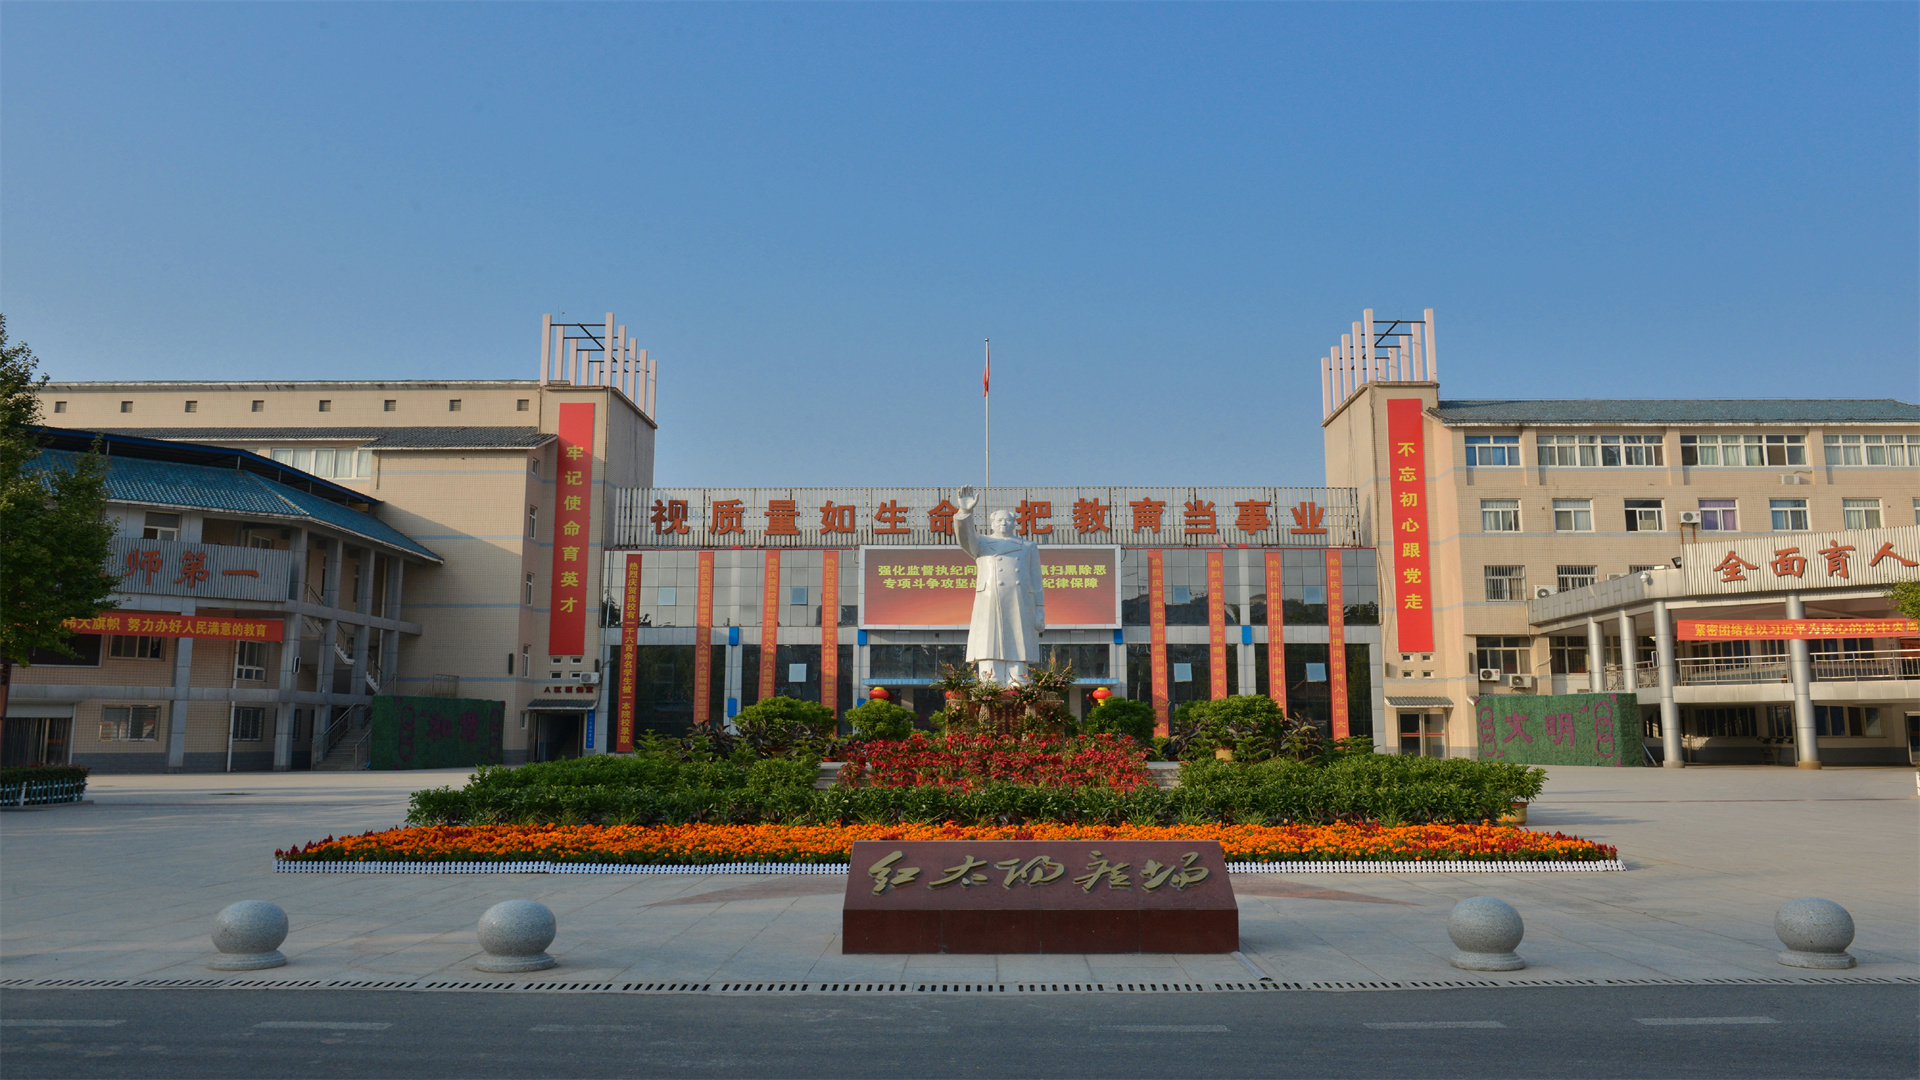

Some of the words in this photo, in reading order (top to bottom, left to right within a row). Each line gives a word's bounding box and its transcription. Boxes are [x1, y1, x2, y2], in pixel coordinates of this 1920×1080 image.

[560, 445, 584, 613] 牢记使命育英才
[650, 498, 959, 537] 视质量如生命
[1015, 497, 1328, 536] 把教育当事业
[1397, 442, 1423, 610] 不忘初心跟党走
[99, 548, 259, 588] 师第一
[878, 565, 976, 576] 强化监督执纪问
[1713, 539, 1919, 583] 全面育人
[128, 617, 267, 638] 努力办好人民满意的教育
[427, 711, 480, 742] 和谐
[1503, 710, 1575, 746] 文明
